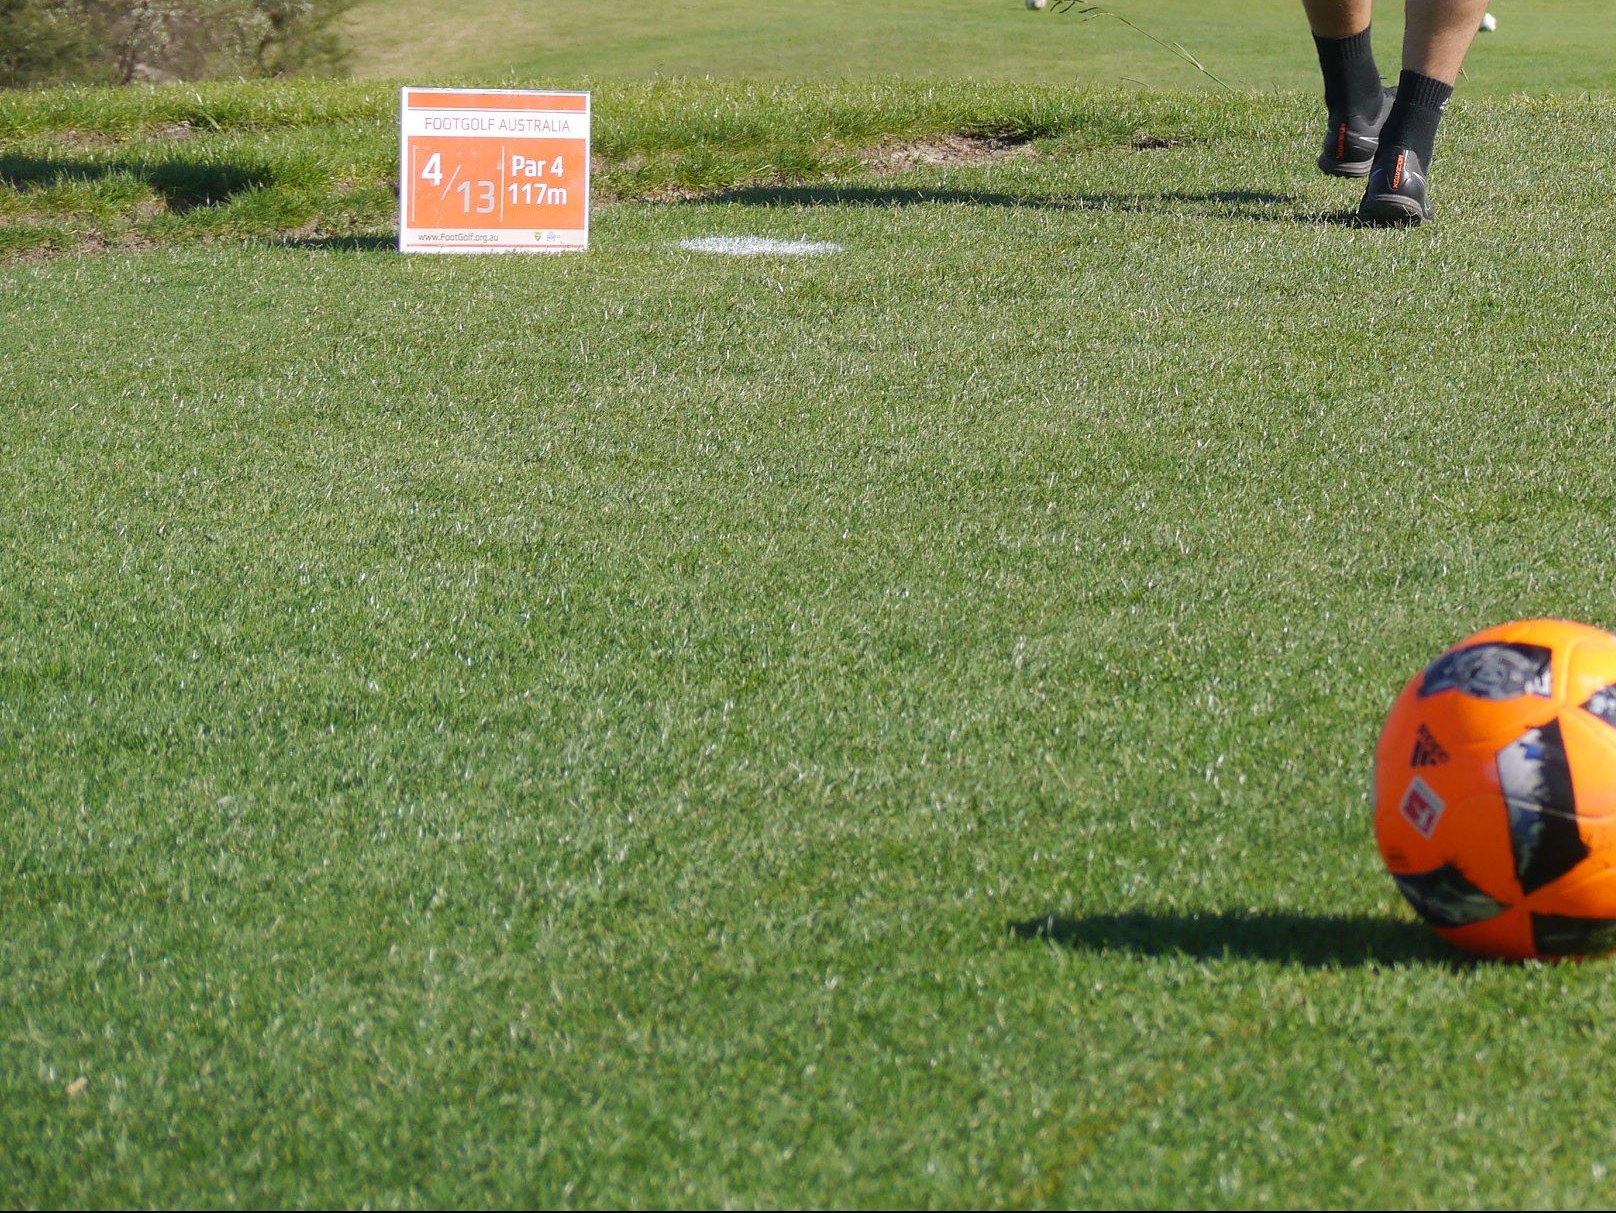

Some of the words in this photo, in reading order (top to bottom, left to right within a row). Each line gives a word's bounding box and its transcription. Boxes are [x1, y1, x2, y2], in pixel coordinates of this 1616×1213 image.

[425, 118, 495, 131] FOOTGOLF
[499, 118, 571, 132] AUSTRALIA
[512, 154, 546, 177] Par
[550, 156, 564, 177] 4
[508, 183, 567, 205] 117m
[418, 233, 498, 243] www.FootGolf.org.au
